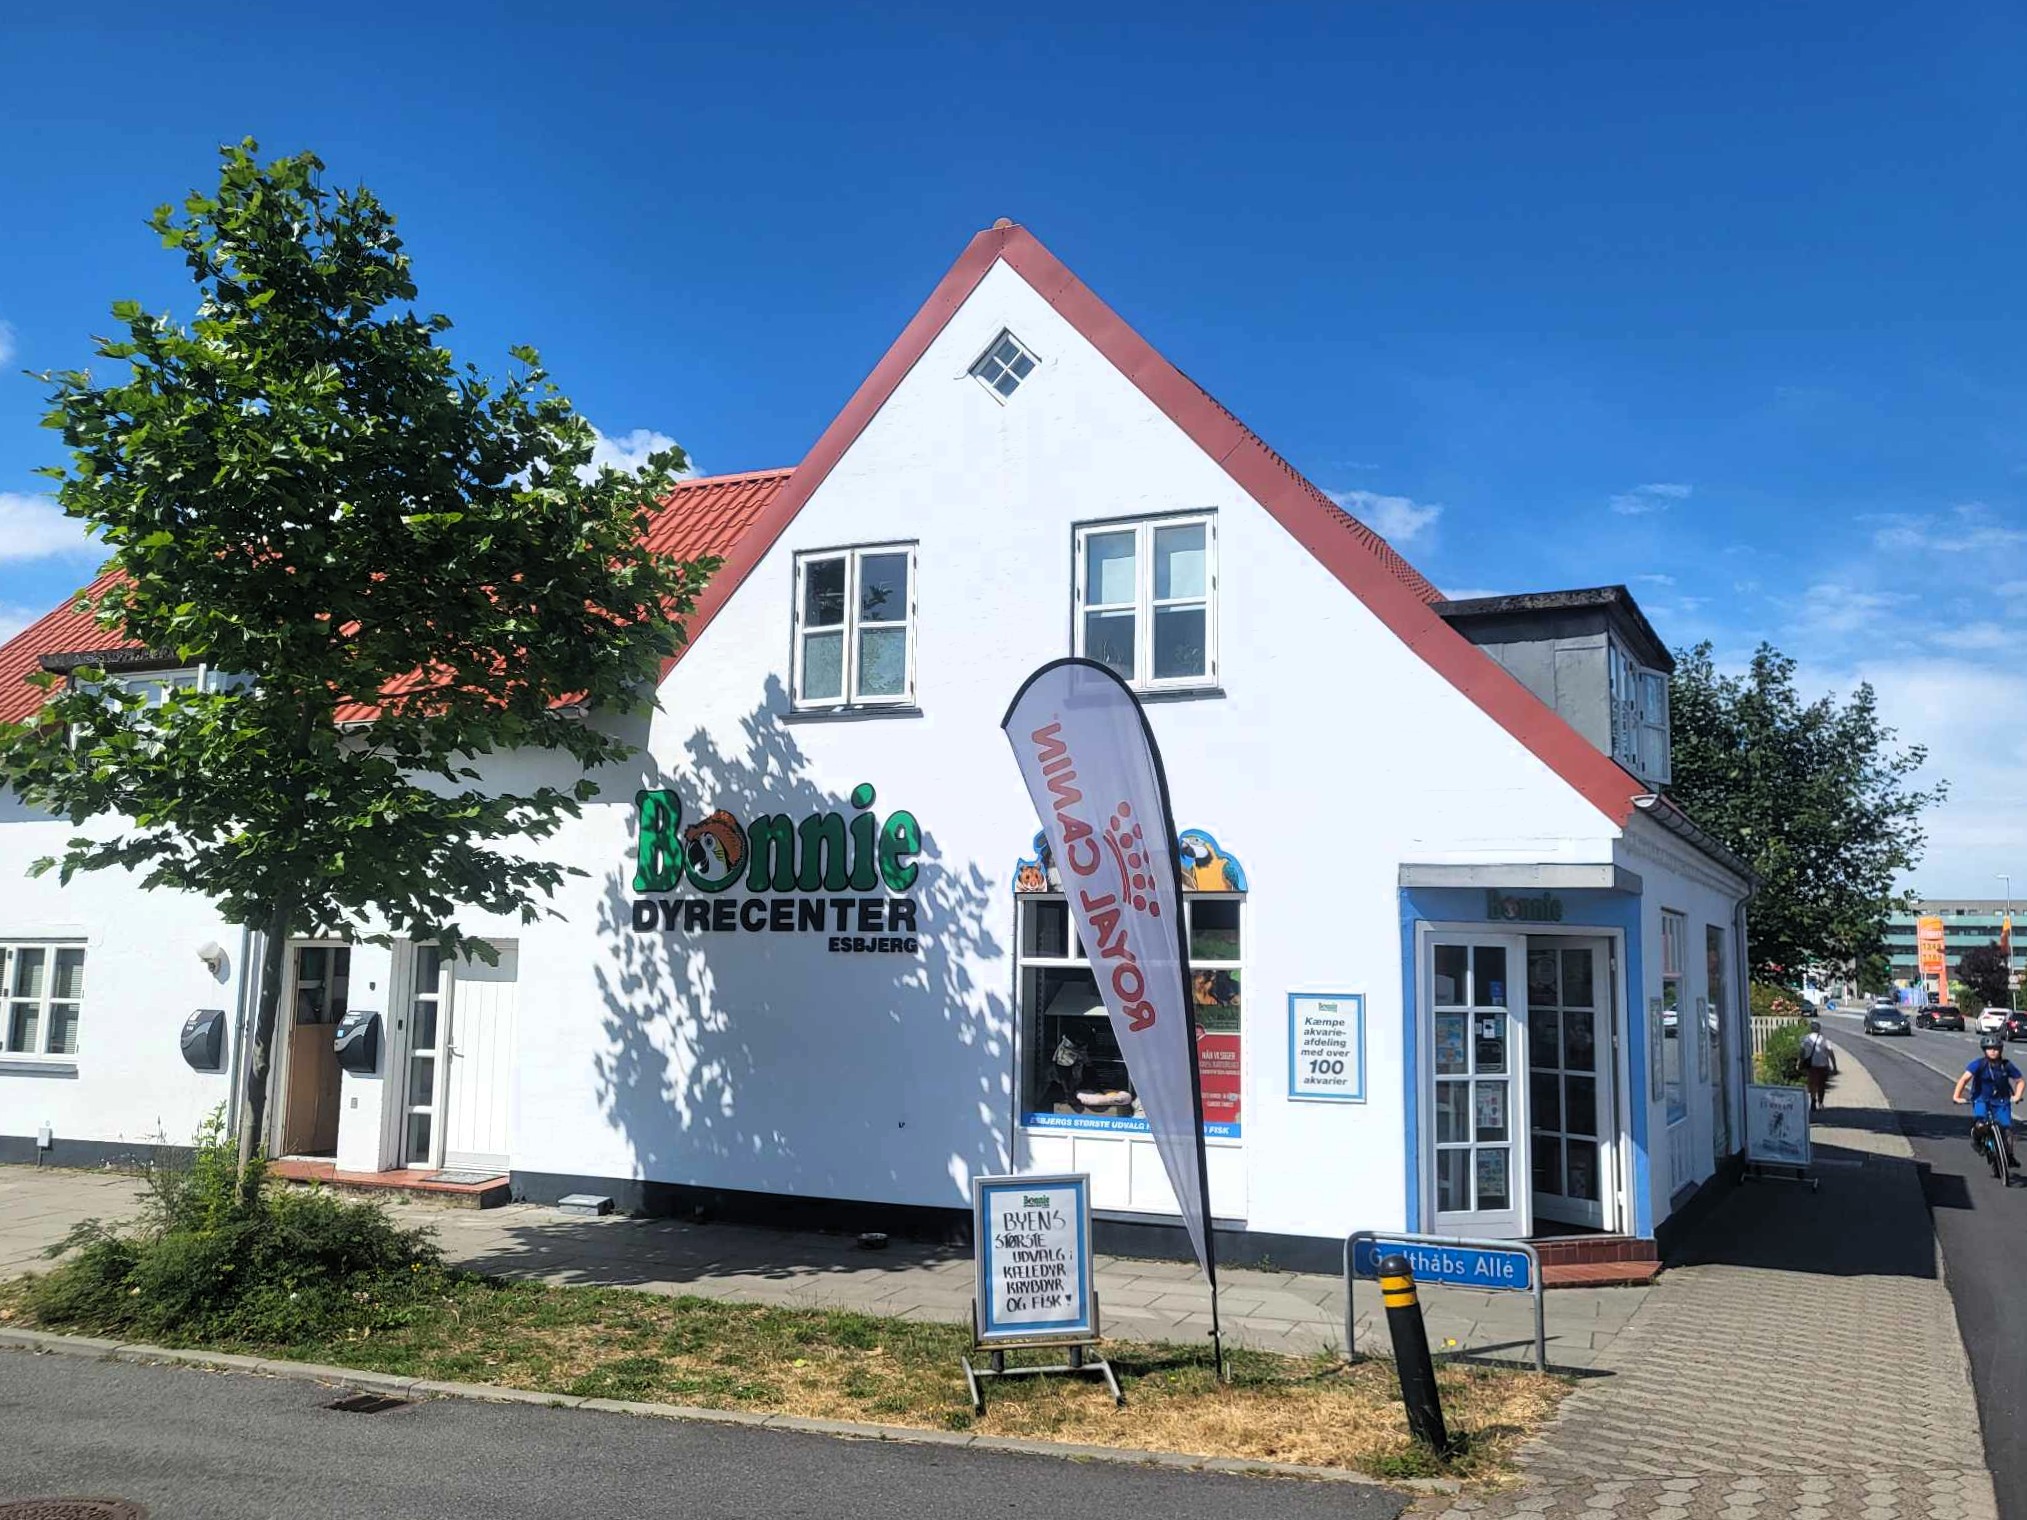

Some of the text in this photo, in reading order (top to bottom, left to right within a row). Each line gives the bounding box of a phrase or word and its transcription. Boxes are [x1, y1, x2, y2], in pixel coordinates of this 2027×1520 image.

[632, 783, 922, 892] Bonnie
[632, 898, 918, 932] DYRECENTER
[828, 936, 919, 953] ESBJERG
[1304, 1016, 1345, 1028] Kæmpe
[1303, 1027, 1347, 1037] akvarie-
[1303, 1037, 1347, 1048] afdeling
[1301, 1048, 1324, 1056] med
[1309, 1059, 1344, 1075] 100
[1303, 1076, 1348, 1086] akvarier
[1073, 1118, 1110, 1129] STØRSTE
[1111, 1120, 1145, 1130] UDVALG
[1208, 1125, 1230, 1135] FISK
[1003, 1210, 1067, 1231] BYENS
[995, 1233, 1047, 1249] STØRSTE
[1013, 1248, 1065, 1263] UDVALG
[1368, 1247, 1514, 1279] Gthåbs Allé
[1003, 1263, 1066, 1279] KÆLEDYR
[1006, 1278, 1064, 1295] KRYBDYR
[1006, 1298, 1026, 1312] OG
